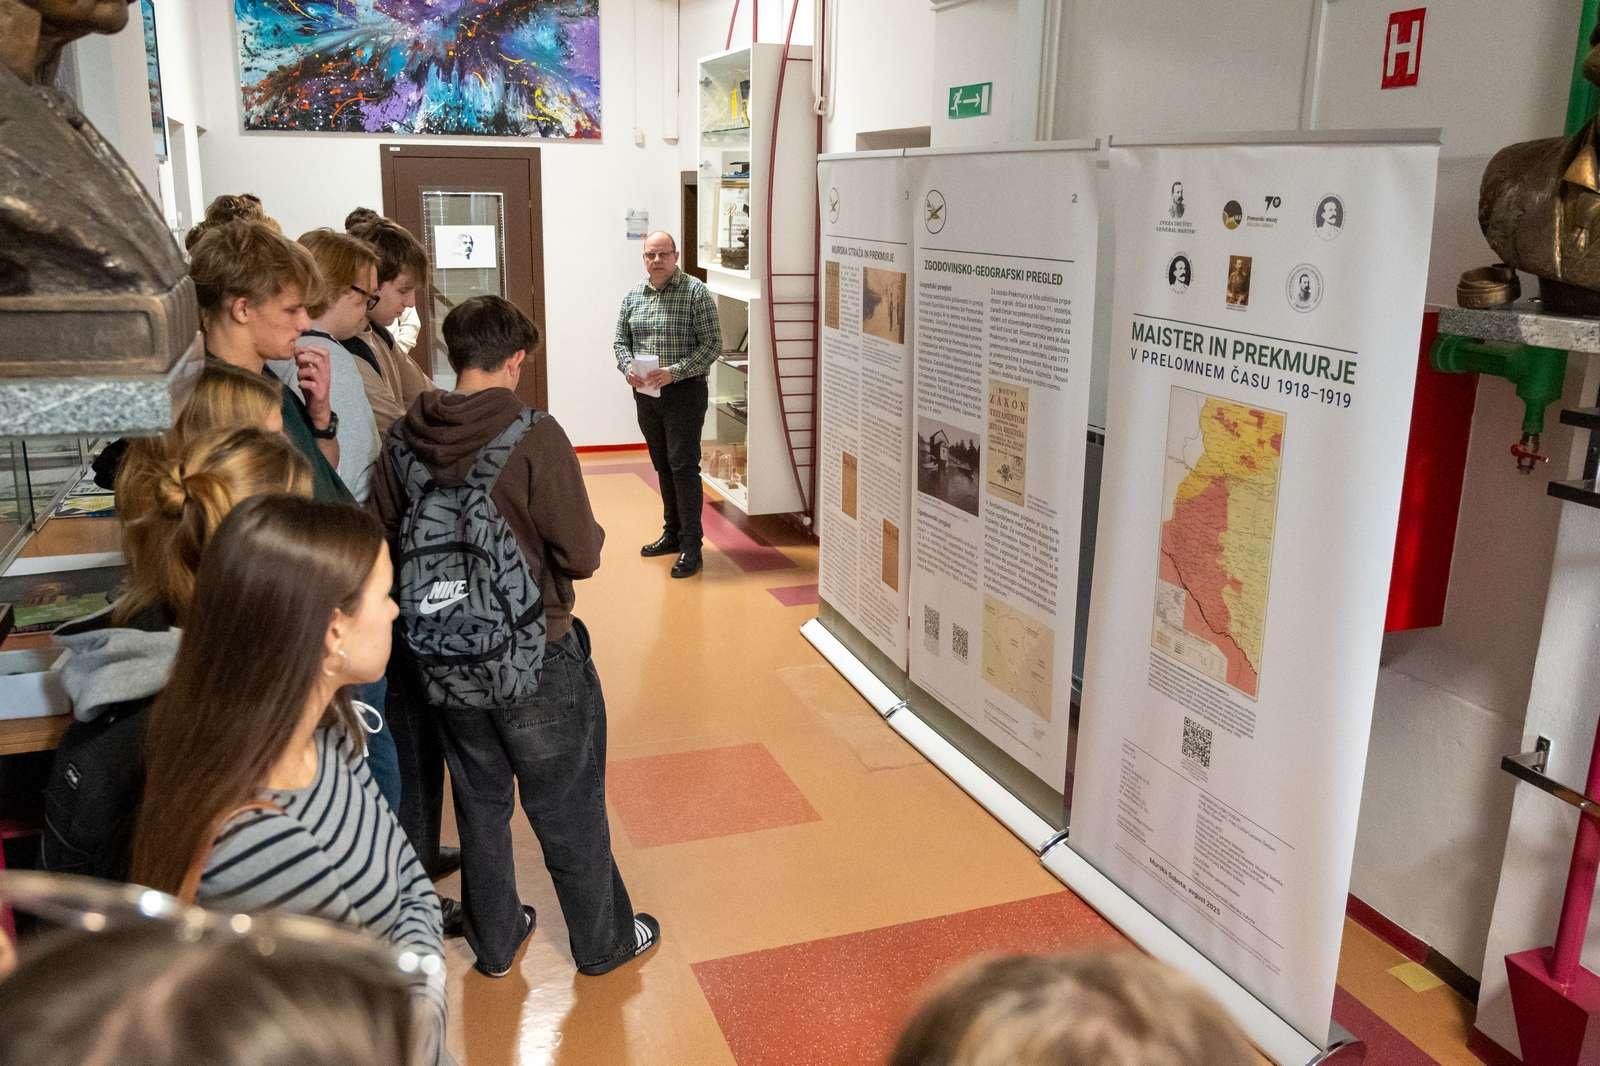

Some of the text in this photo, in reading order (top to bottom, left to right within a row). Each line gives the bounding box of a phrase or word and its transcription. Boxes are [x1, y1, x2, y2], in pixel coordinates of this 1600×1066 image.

[1386, 20, 1420, 77] H
[1071, 192, 1079, 204] 2
[924, 259, 1063, 286] ZGODOVINSKO-GEOGRAFSKI PREGLED
[1131, 321, 1358, 385] MAISTER IN PREKMURJE
[1130, 347, 1138, 361] V
[1141, 350, 1225, 380] PRELOMNEM
[1230, 366, 1271, 390] ČASU
[429, 580, 467, 599] NIKE
[1206, 900, 1221, 916] 2025
